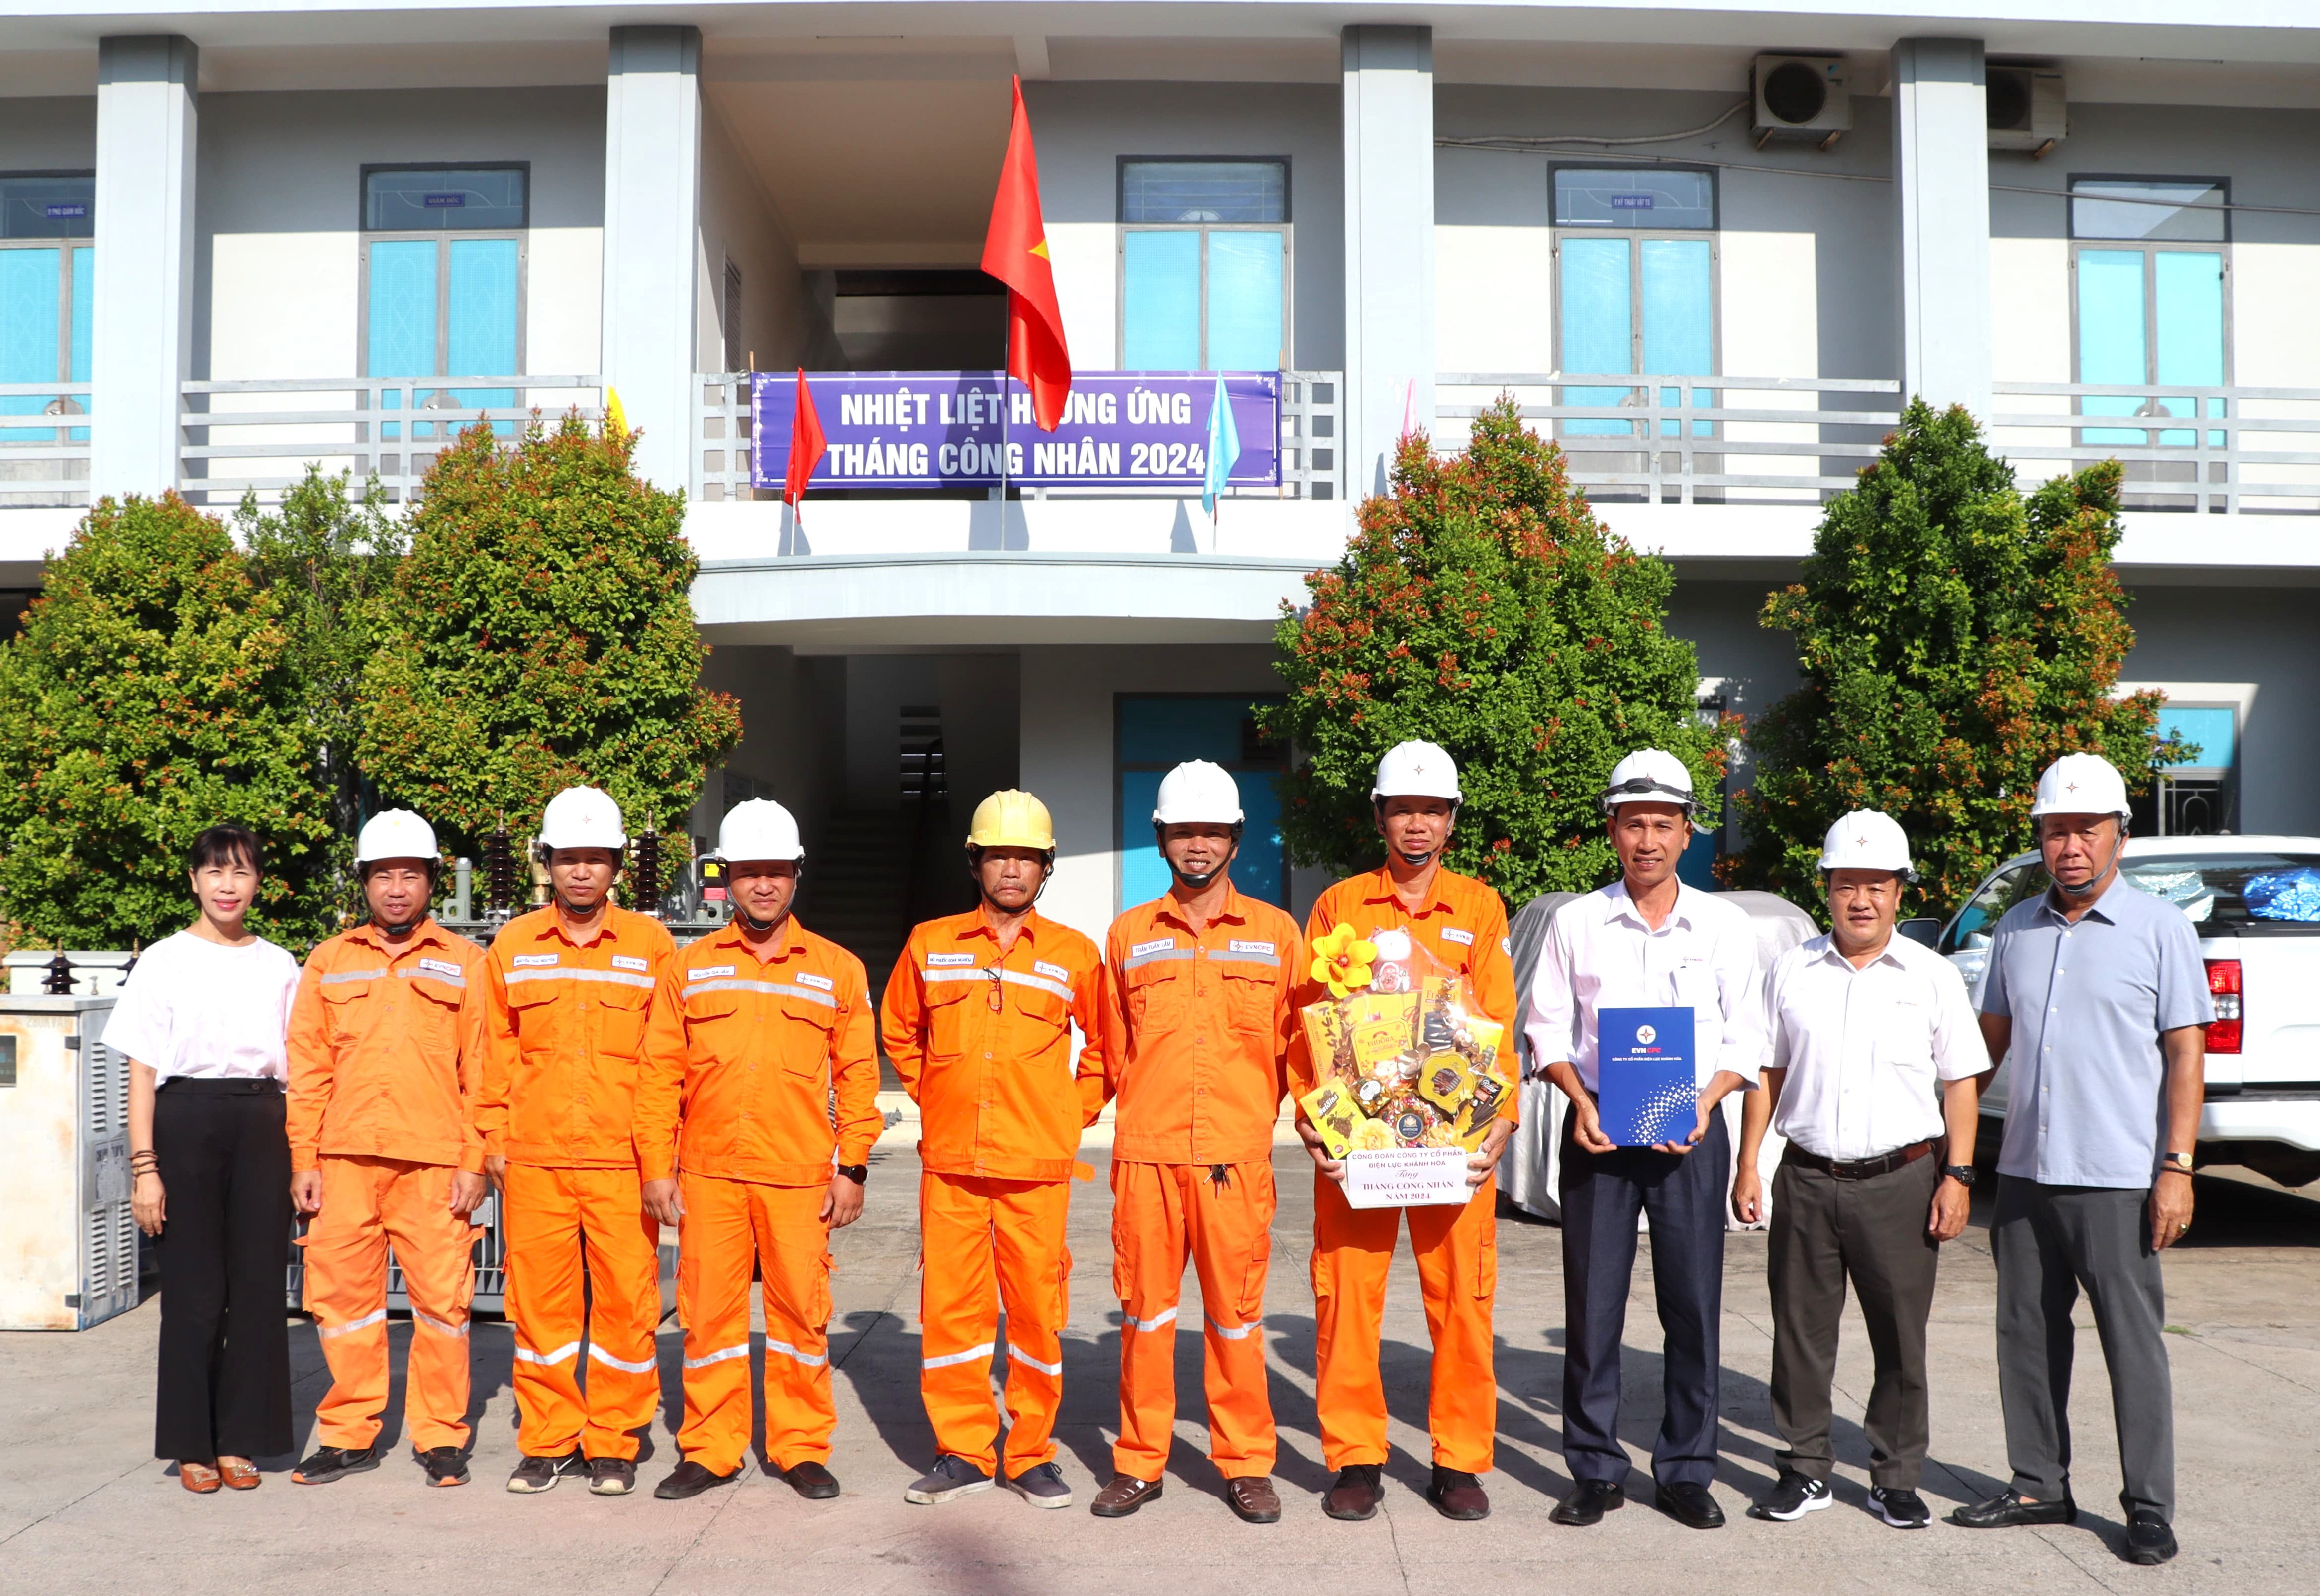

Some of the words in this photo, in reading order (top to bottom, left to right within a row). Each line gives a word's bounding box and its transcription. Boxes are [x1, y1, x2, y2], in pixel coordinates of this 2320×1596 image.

[841, 387, 930, 431] NHIỆT
[940, 387, 1002, 431] LIỆT
[1011, 390, 1116, 424] HNG
[1127, 386, 1191, 424] ỨNG
[827, 437, 928, 475] THÁNG
[939, 437, 1023, 475] CÔNG
[1034, 436, 1120, 474] NHÂN
[1130, 443, 1205, 474] 2024
